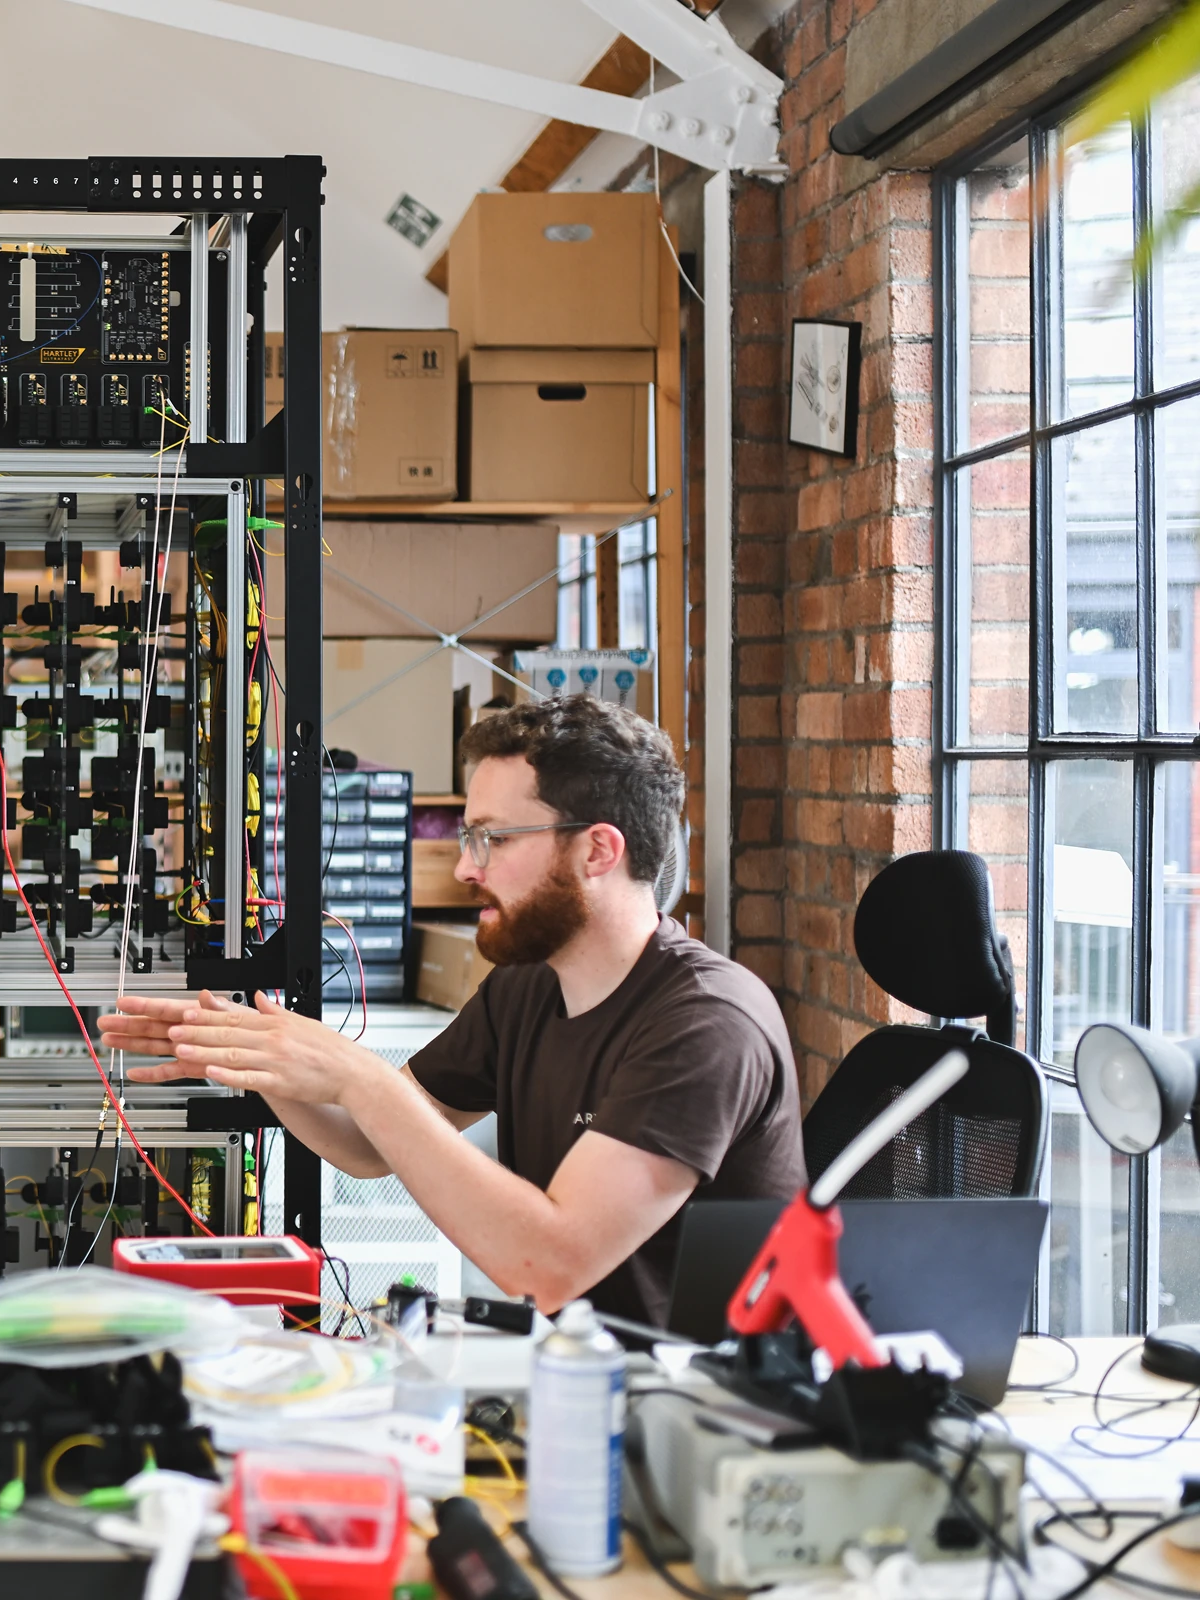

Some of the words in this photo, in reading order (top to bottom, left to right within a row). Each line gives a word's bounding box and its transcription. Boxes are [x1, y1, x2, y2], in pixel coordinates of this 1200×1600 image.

[12, 176, 19, 185] 4
[33, 177, 40, 185] 5
[53, 177, 60, 186] 6
[73, 177, 80, 186] 7
[93, 177, 100, 186] 8
[113, 177, 120, 186] 9
[572, 1112, 597, 1125] AR
